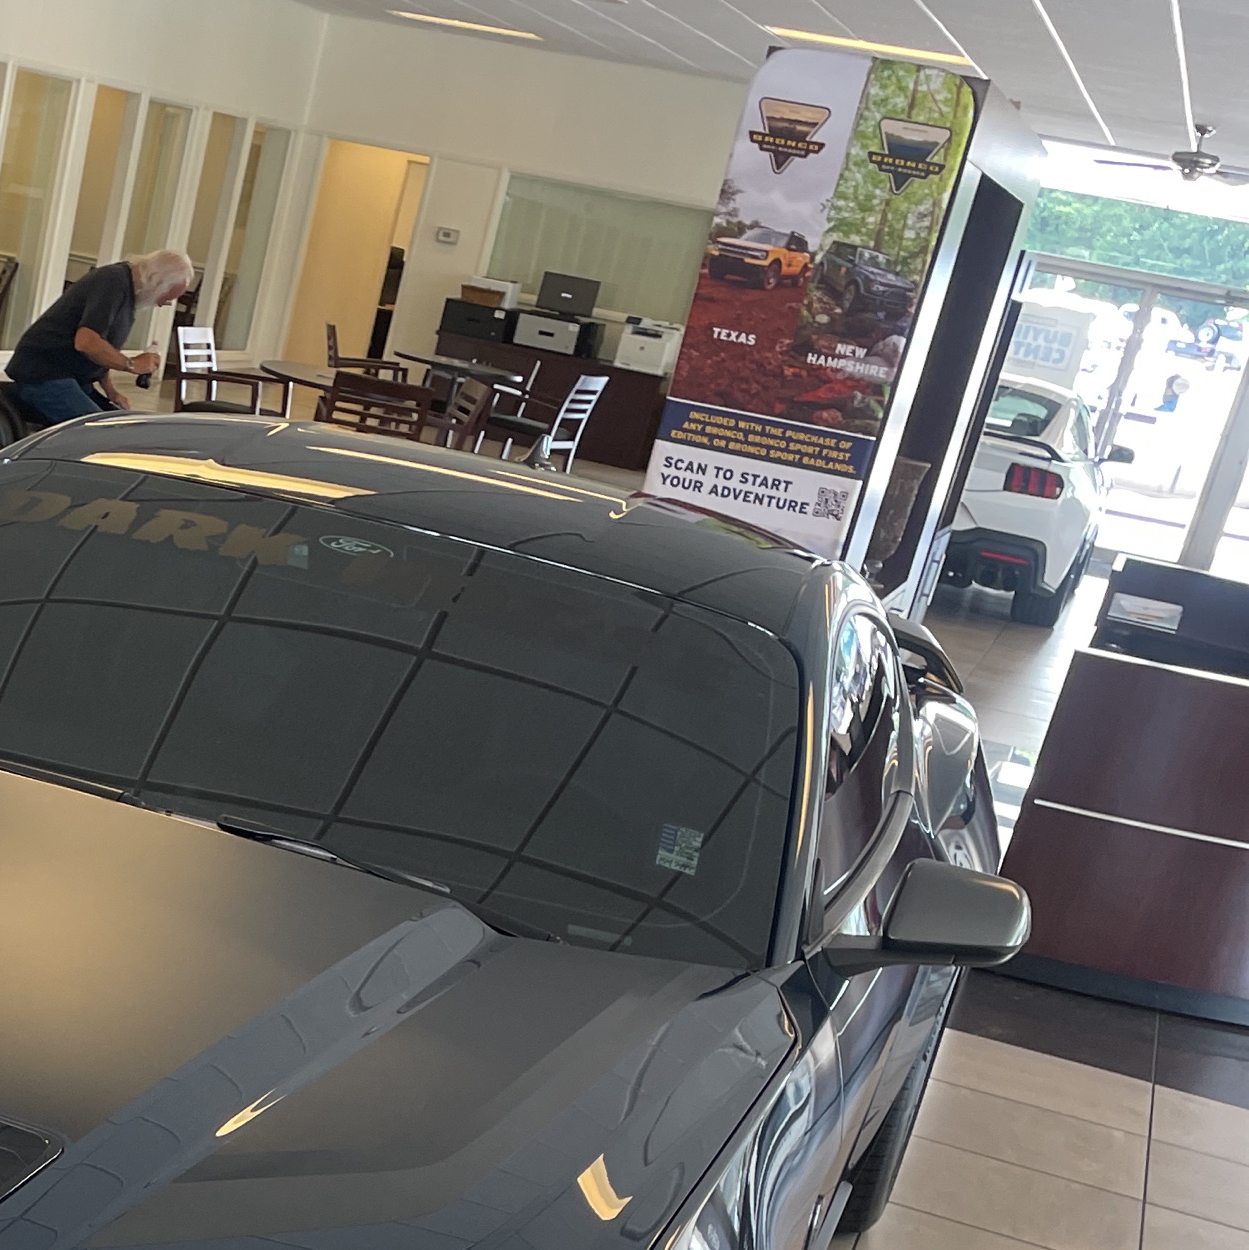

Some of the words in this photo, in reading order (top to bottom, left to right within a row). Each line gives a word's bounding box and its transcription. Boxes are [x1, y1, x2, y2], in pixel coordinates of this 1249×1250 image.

[753, 134, 819, 151] BRONCO
[871, 154, 940, 172] BRONCO
[712, 327, 757, 346] TEXAS
[835, 343, 868, 359] NEW
[806, 353, 889, 379] HAMPSHIRE
[682, 421, 703, 432] ANY
[704, 426, 746, 441] BRONCO,
[747, 434, 787, 449] BRONCO
[789, 442, 821, 455] SPORT
[822, 449, 851, 461] FIRST
[689, 410, 736, 427] INCLUDED
[738, 420, 762, 433] WITH
[765, 425, 784, 437] THE
[785, 429, 837, 447] PURCHASE
[839, 440, 853, 449] OF
[670, 429, 710, 445] EDITION,
[713, 438, 726, 448] OR
[728, 441, 767, 457] BRONCO
[769, 448, 800, 463] SPORT
[802, 456, 857, 474] BADLANDS.
[663, 456, 708, 476] SCAN
[713, 466, 734, 481] TO
[739, 472, 793, 493] START
[660, 472, 704, 493] YOUR
[708, 483, 810, 515] ADVENTURE
